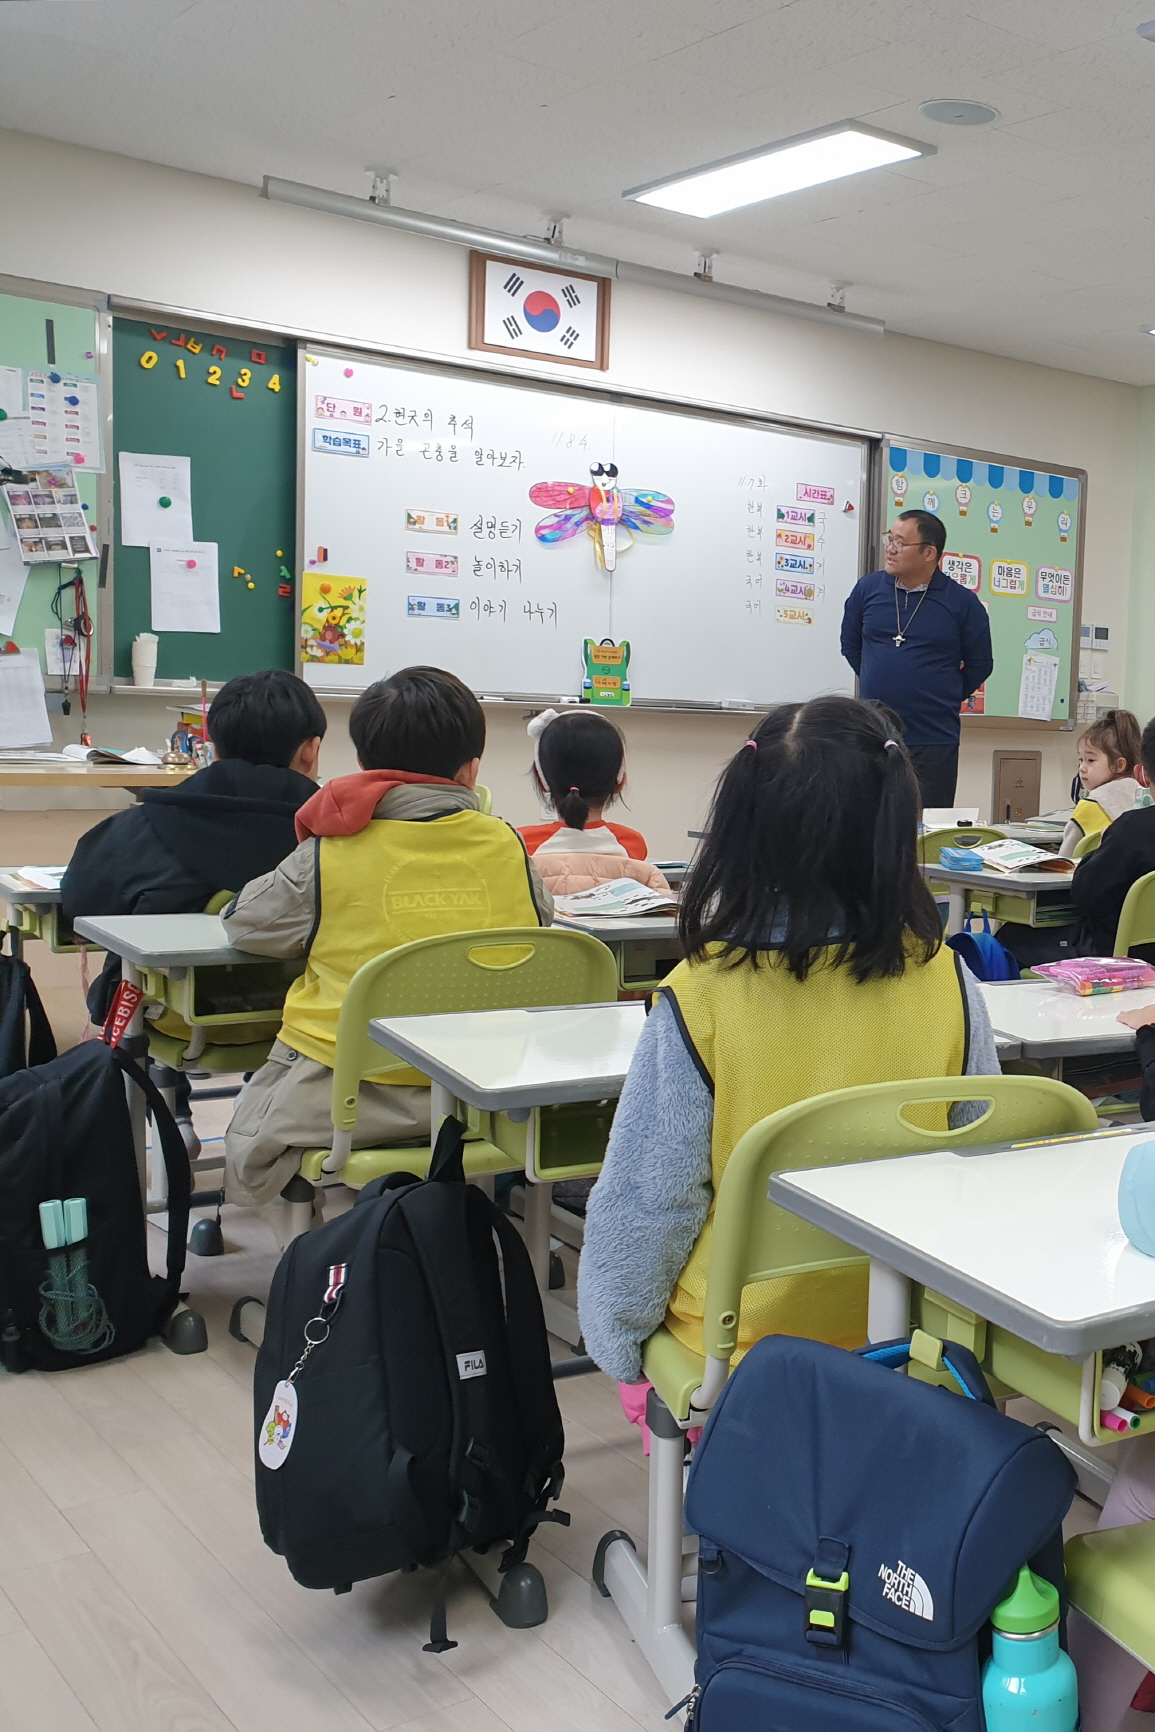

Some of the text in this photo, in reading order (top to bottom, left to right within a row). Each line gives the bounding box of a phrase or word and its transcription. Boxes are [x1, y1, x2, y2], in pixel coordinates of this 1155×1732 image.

[206, 365, 222, 386] 2
[237, 368, 251, 387] 3
[267, 374, 281, 392] 4
[447, 413, 474, 442] 추석
[322, 435, 362, 449] 학습목표
[377, 437, 405, 457] 가을
[419, 442, 459, 462] 곤충을
[803, 486, 829, 500] 시간표
[785, 510, 807, 522] 1교시
[469, 514, 522, 543] 설명듣기
[784, 534, 806, 546] 2교시
[472, 555, 522, 584] 놀이하기
[784, 558, 806, 570] 3교시
[947, 560, 974, 573] 생각은
[997, 565, 1022, 579] 마음은
[1040, 571, 1070, 586] 무엇이든
[784, 584, 808, 597] 4교시
[993, 577, 1025, 591] 너그럽게
[469, 596, 557, 630] 이야기 나누기
[783, 609, 805, 621] 5교시
[391, 892, 482, 910] BLACK YAK
[464, 1358, 485, 1372] FILA
[896, 1560, 916, 1585] THE
[878, 1563, 913, 1598] NORTH
[882, 1583, 911, 1611] FACE
